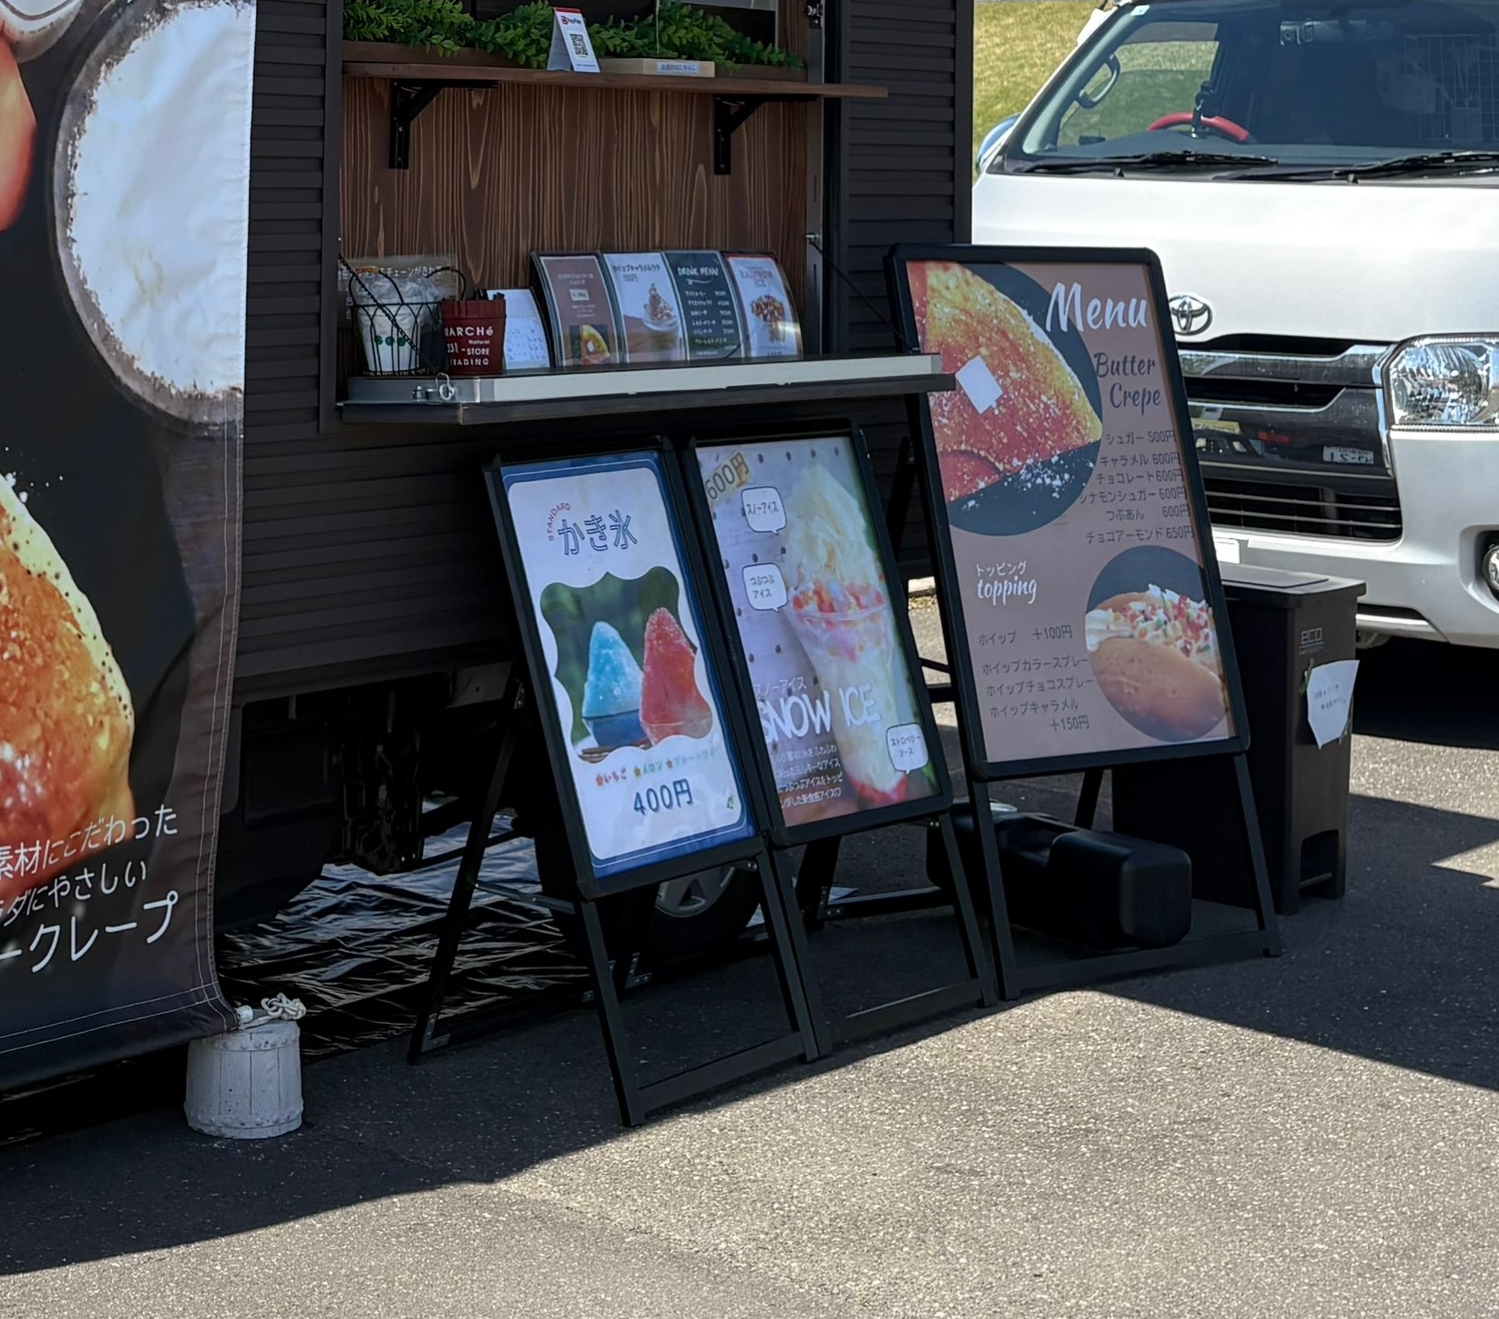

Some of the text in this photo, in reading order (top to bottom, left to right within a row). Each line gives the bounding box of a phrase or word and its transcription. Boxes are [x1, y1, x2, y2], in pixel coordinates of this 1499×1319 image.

[1045, 282, 1148, 332] Menu
[1094, 352, 1156, 379] Butter
[1110, 383, 1161, 416] Crepe
[1106, 429, 1176, 445] シュガー 500円
[1100, 452, 1180, 468] キャラメル 600円
[706, 451, 751, 501] 600円
[1096, 468, 1184, 485] チョコレート 600円
[1079, 486, 1187, 504] シナモンシュガー 600円
[546, 502, 571, 541] STANDARD
[1105, 504, 1191, 521] つぶあん 600円
[557, 509, 638, 556] かき氷
[1086, 525, 1195, 544] チョコアーモンド 650円
[976, 561, 1027, 576] トッピング
[977, 575, 1037, 606] topping
[978, 631, 1016, 646] ホイップ
[982, 656, 1089, 675] ホイップカラースプレー
[986, 676, 1093, 697] ホイップチョコスプレー
[840, 683, 883, 728] ICE
[990, 698, 1079, 719] ホイップキャラメル
[633, 778, 693, 816] 400円
